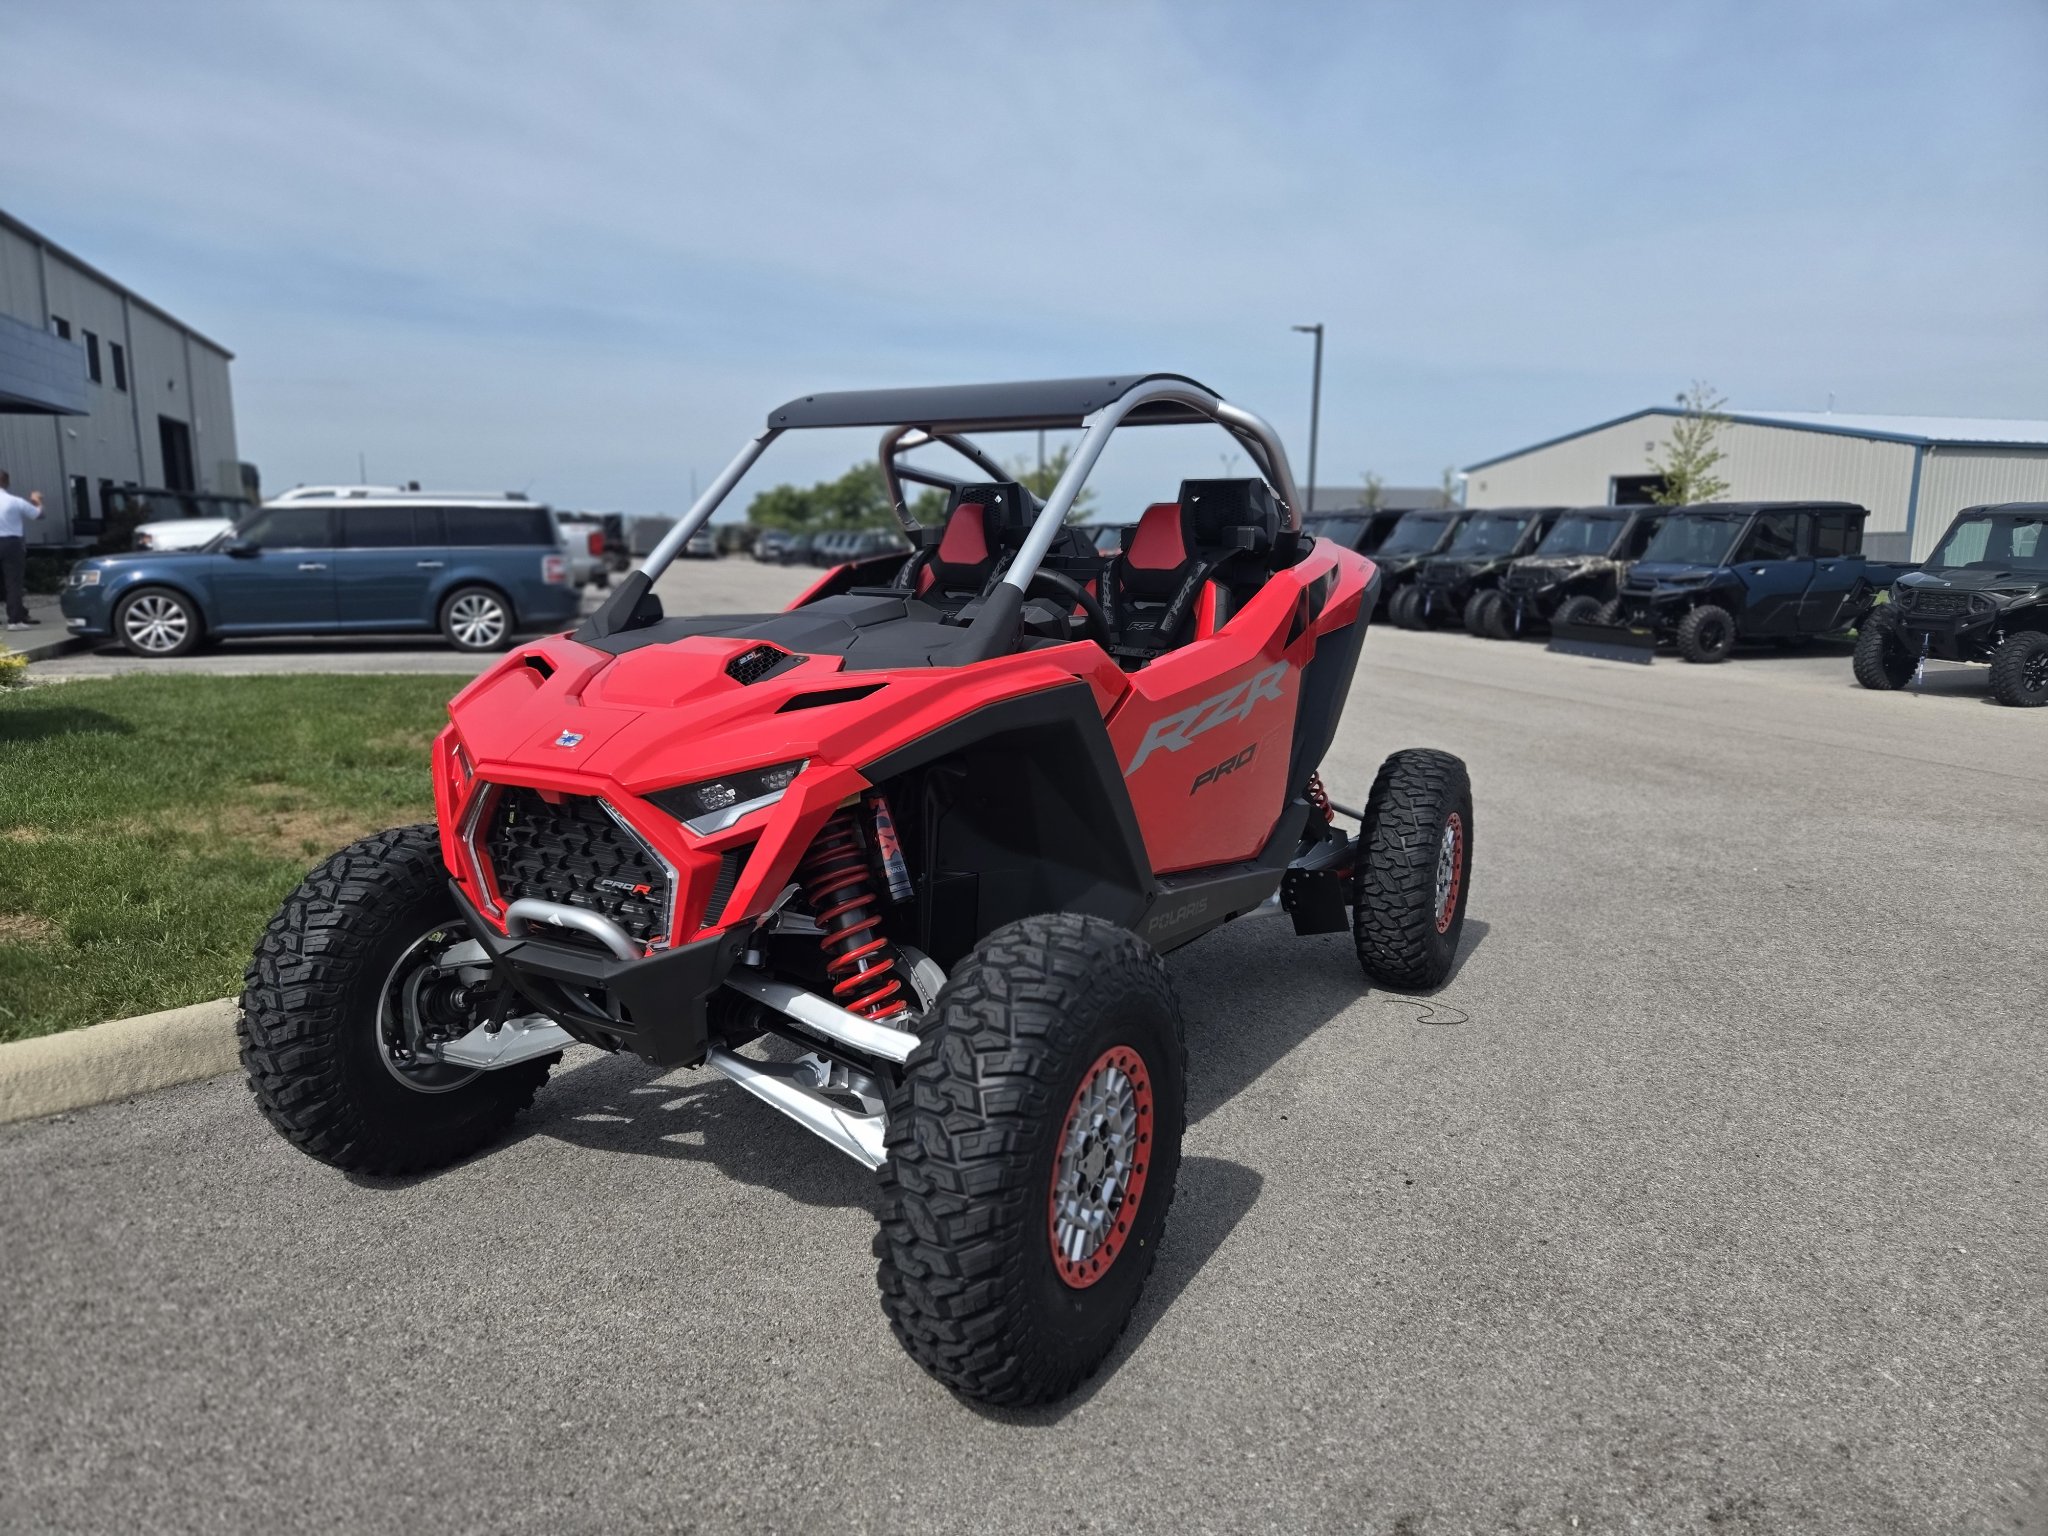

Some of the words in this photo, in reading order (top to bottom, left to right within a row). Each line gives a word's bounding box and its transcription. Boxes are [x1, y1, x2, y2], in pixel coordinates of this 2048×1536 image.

[1124, 659, 1290, 779] RZR
[1189, 742, 1258, 797] PRO
[1147, 896, 1208, 934] POLARIS
